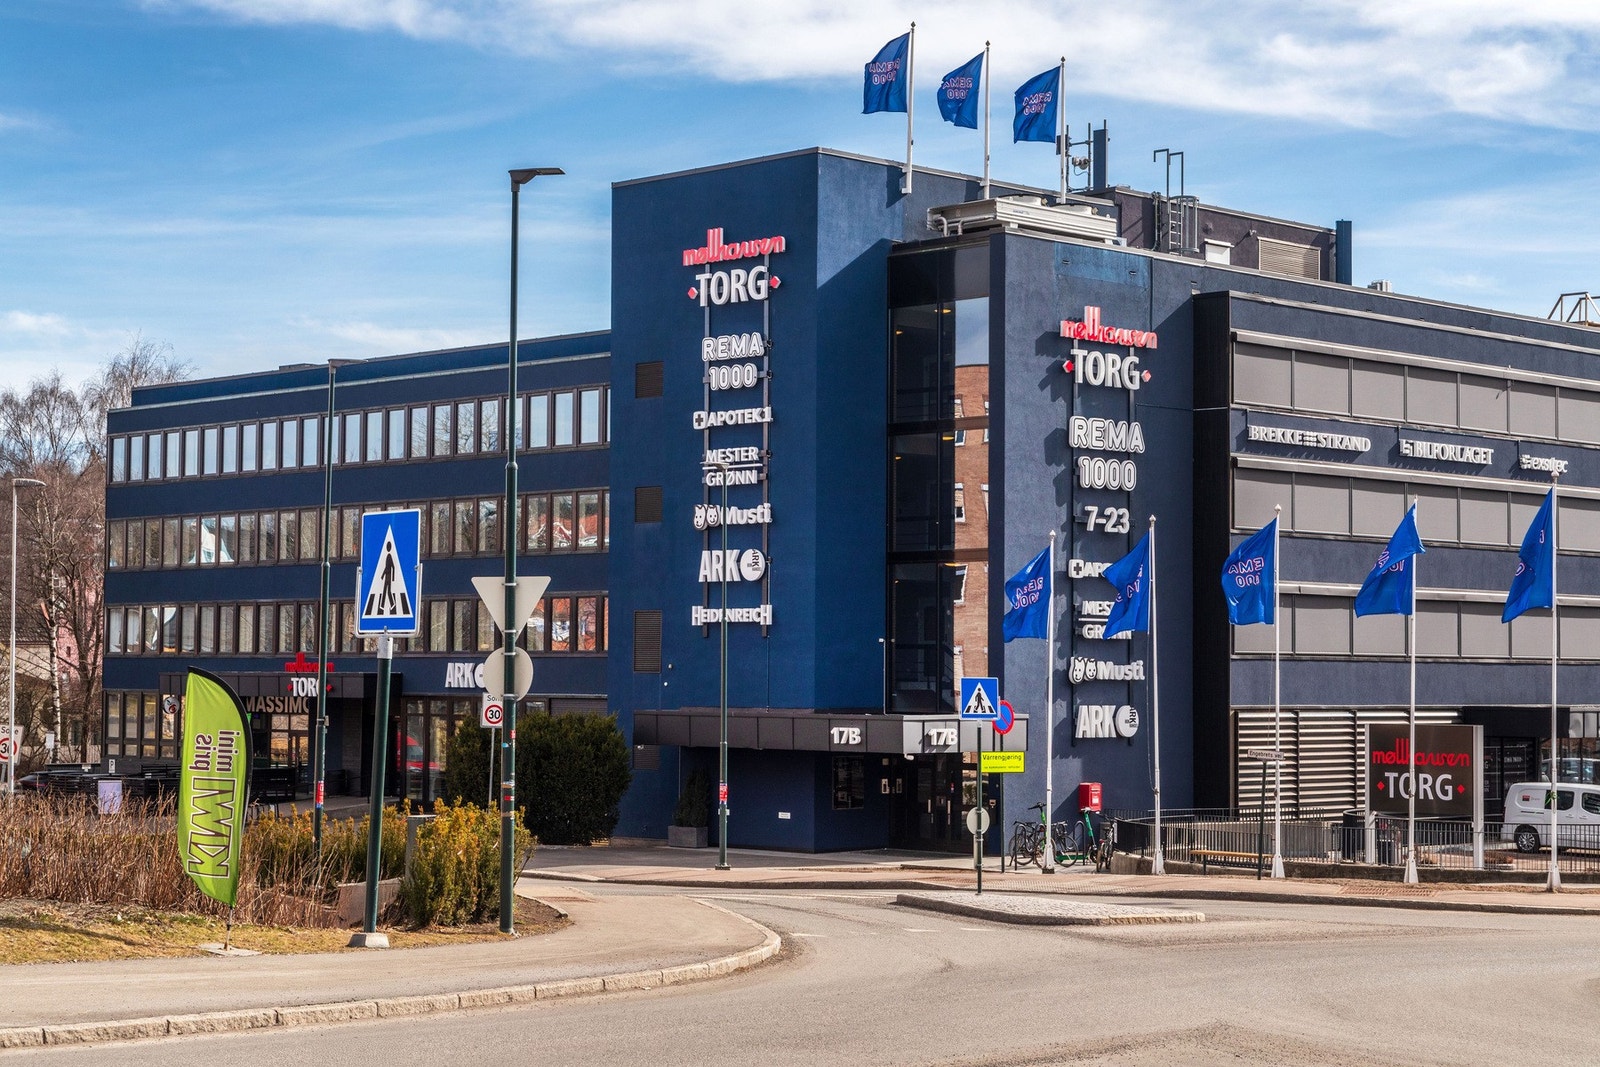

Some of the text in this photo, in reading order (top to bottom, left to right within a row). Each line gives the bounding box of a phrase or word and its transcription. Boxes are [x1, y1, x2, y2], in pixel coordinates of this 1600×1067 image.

[695, 265, 769, 307] TORG
[702, 332, 764, 361] REMA
[709, 363, 757, 390] 1000
[1070, 348, 1140, 390] TORG
[1069, 415, 1145, 453] REMA
[1247, 424, 1371, 452] BREKKE STRAND
[705, 446, 759, 463] MESTER
[1414, 441, 1494, 465] BILFORLAGET
[706, 470, 758, 486] GRØNN
[1078, 456, 1137, 491] 1000
[721, 502, 772, 525] Musti
[1084, 505, 1130, 534] 7-23
[698, 549, 741, 582] ARK
[445, 663, 476, 688] ARK
[1096, 660, 1145, 680] Musti
[488, 709, 501, 720] 30
[1075, 705, 1117, 738] ARK
[1, 726, 19, 735] Soe
[831, 727, 861, 745] 17B
[928, 728, 958, 746] 17B
[1384, 772, 1453, 801] TORG
